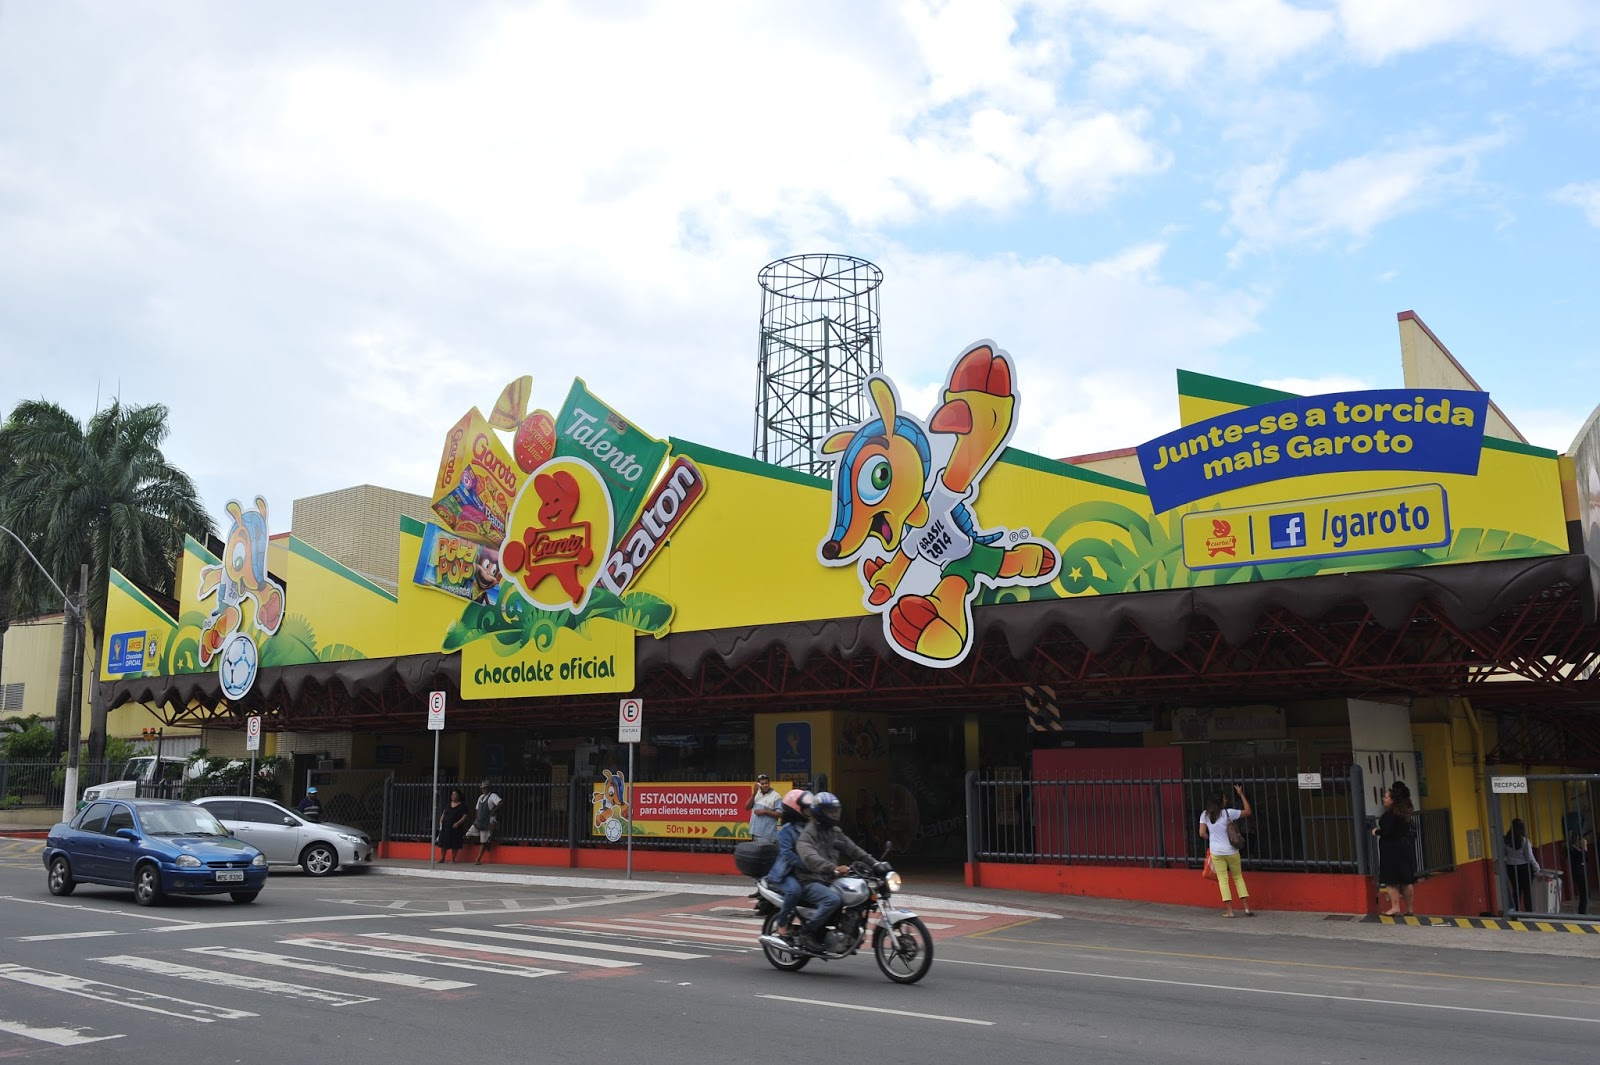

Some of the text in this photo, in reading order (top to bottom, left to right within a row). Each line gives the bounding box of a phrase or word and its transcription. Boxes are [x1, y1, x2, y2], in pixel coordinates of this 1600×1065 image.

[565, 408, 643, 482] Talento
[1152, 396, 1476, 471] Junte-se a torcida
[444, 428, 464, 486] Garoto
[472, 432, 517, 492] Garoto
[1203, 429, 1414, 480] mais Garoto
[600, 465, 695, 597] Baton
[919, 519, 945, 550] BRASIL
[926, 531, 952, 559] 2014
[1285, 517, 1300, 546] f
[532, 534, 584, 558] Garoto
[474, 655, 615, 685] chocolate oficial
[434, 697, 440, 709] E
[627, 705, 634, 718] E
[639, 807, 657, 816] para
[658, 806, 688, 815] clientes
[704, 808, 738, 817] compras
[640, 793, 738, 805] ESTACIONAMENTO
[666, 825, 685, 834] 50m
